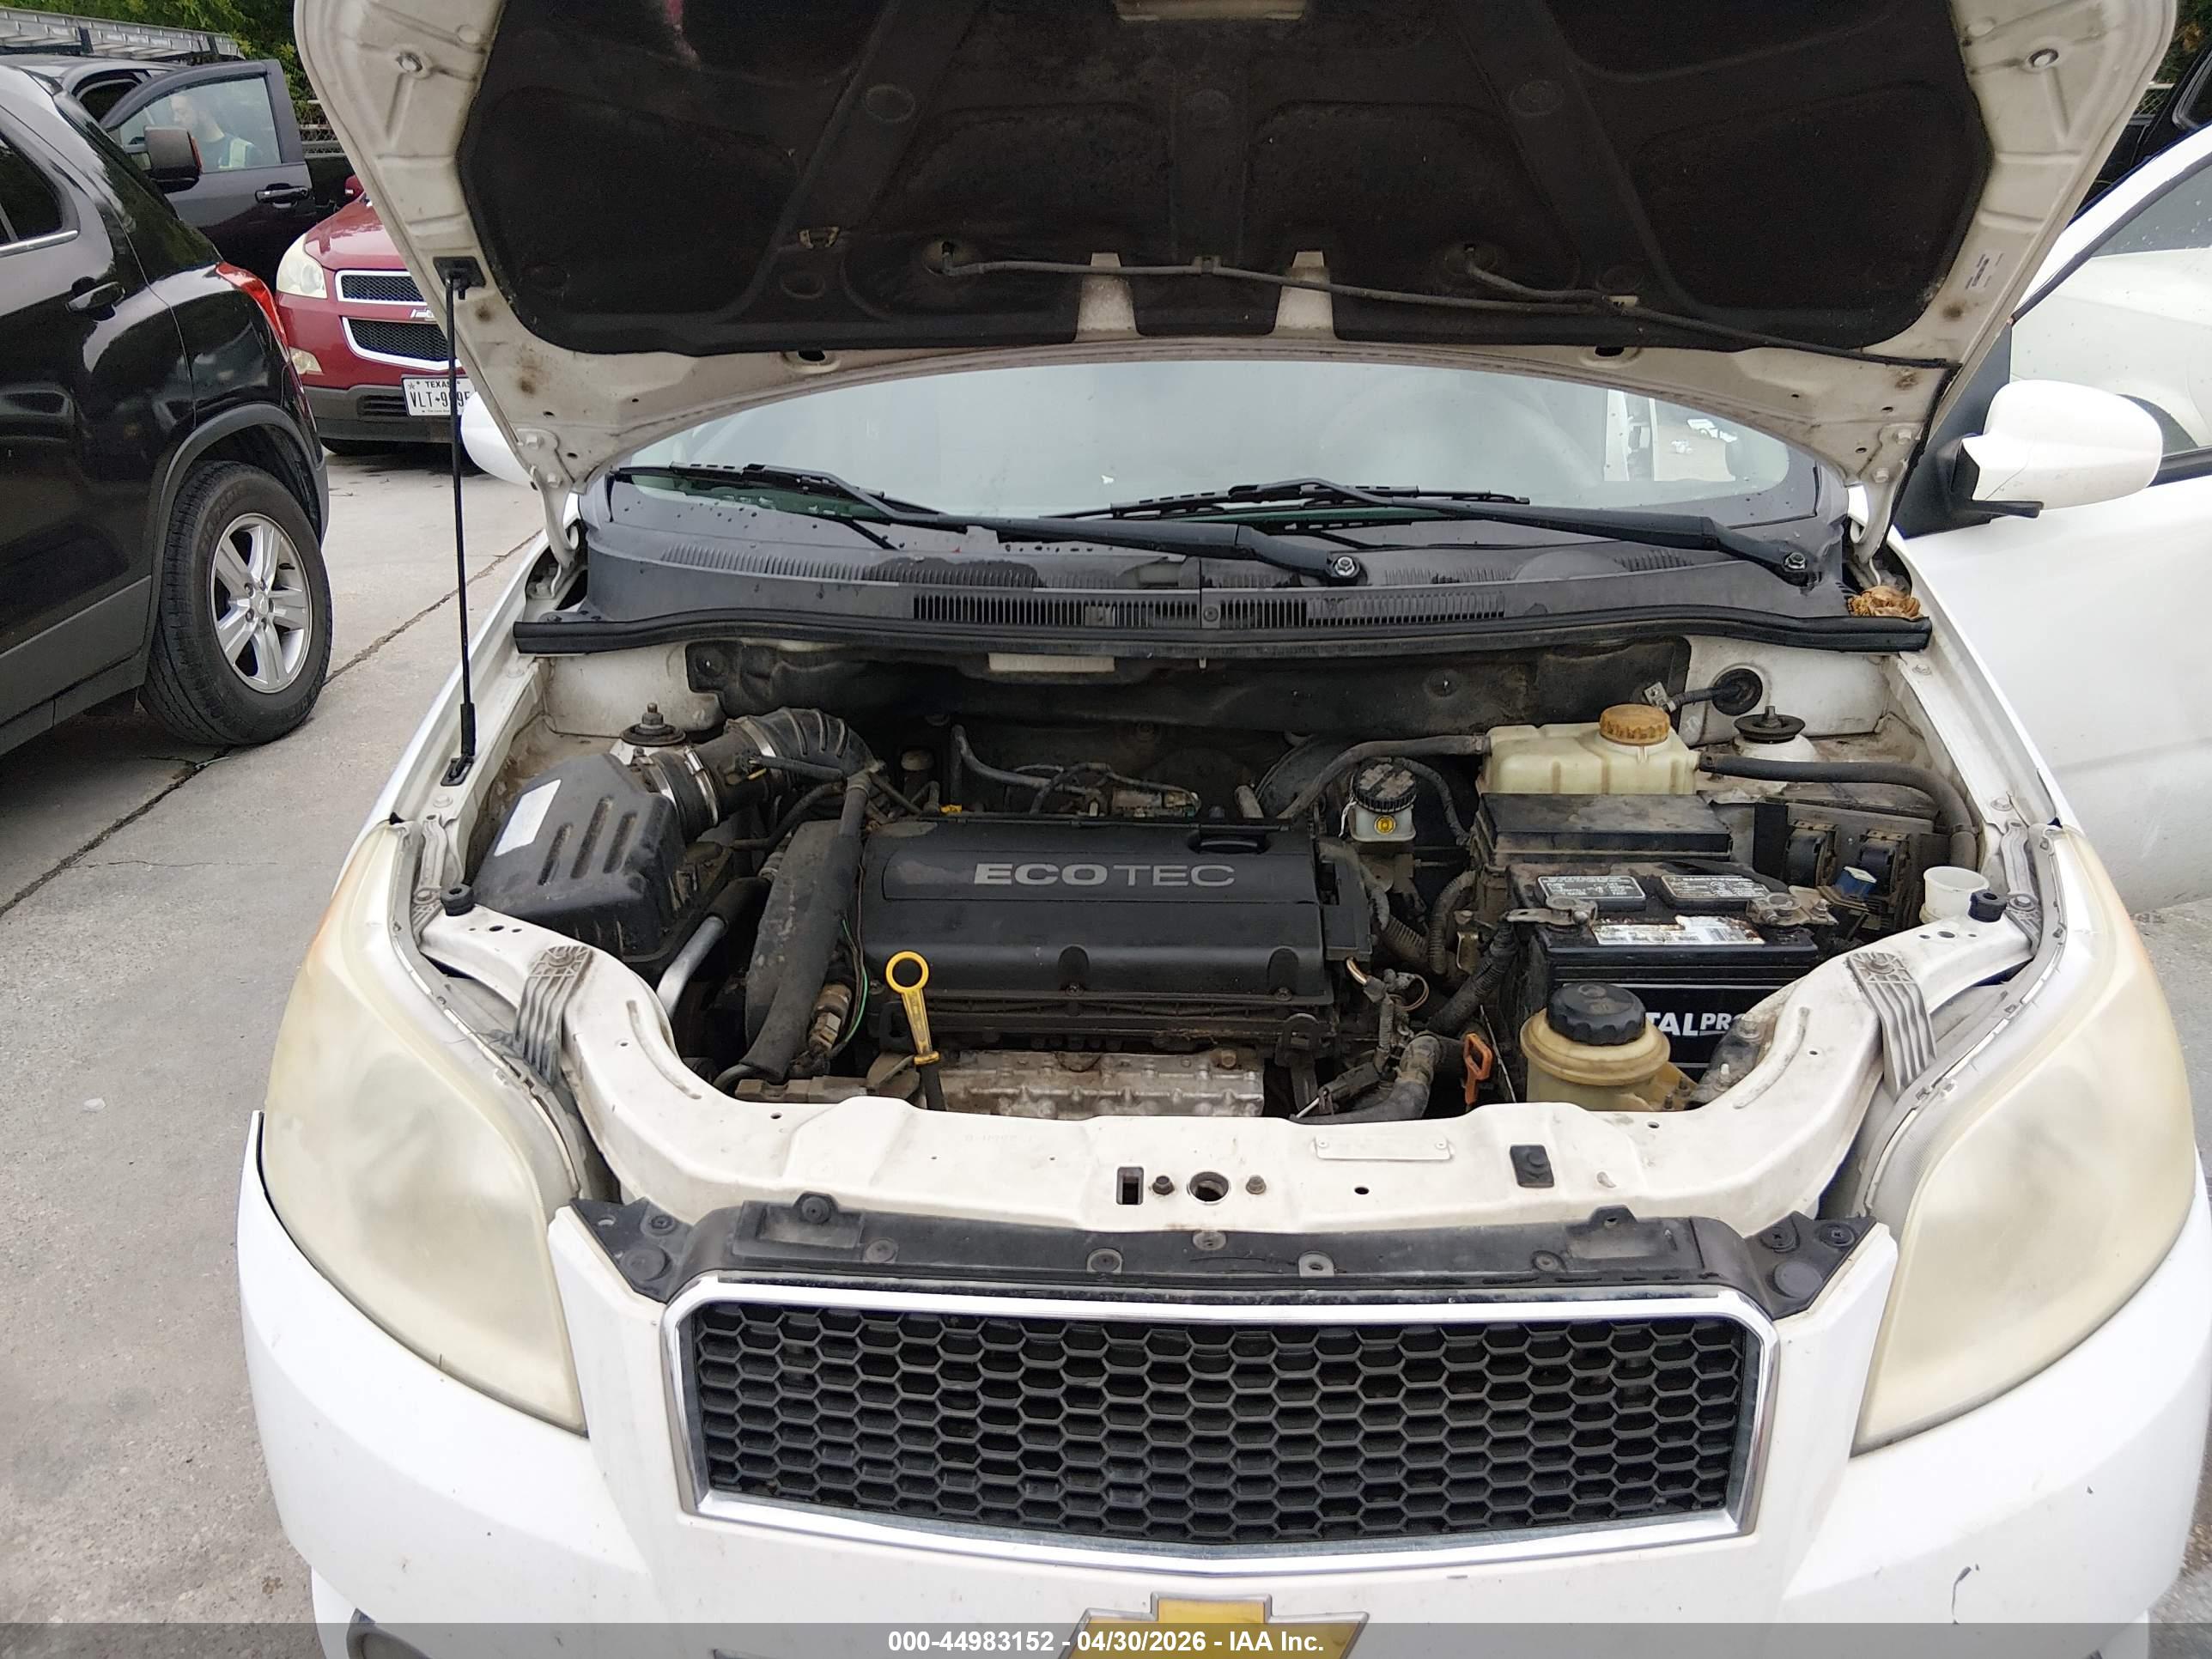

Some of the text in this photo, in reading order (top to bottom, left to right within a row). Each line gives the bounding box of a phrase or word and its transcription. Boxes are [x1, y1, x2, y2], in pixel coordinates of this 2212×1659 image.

[410, 391, 433, 407] VLT
[974, 863, 1235, 886] ECOTEC
[1645, 1012, 1745, 1036] TALPR
